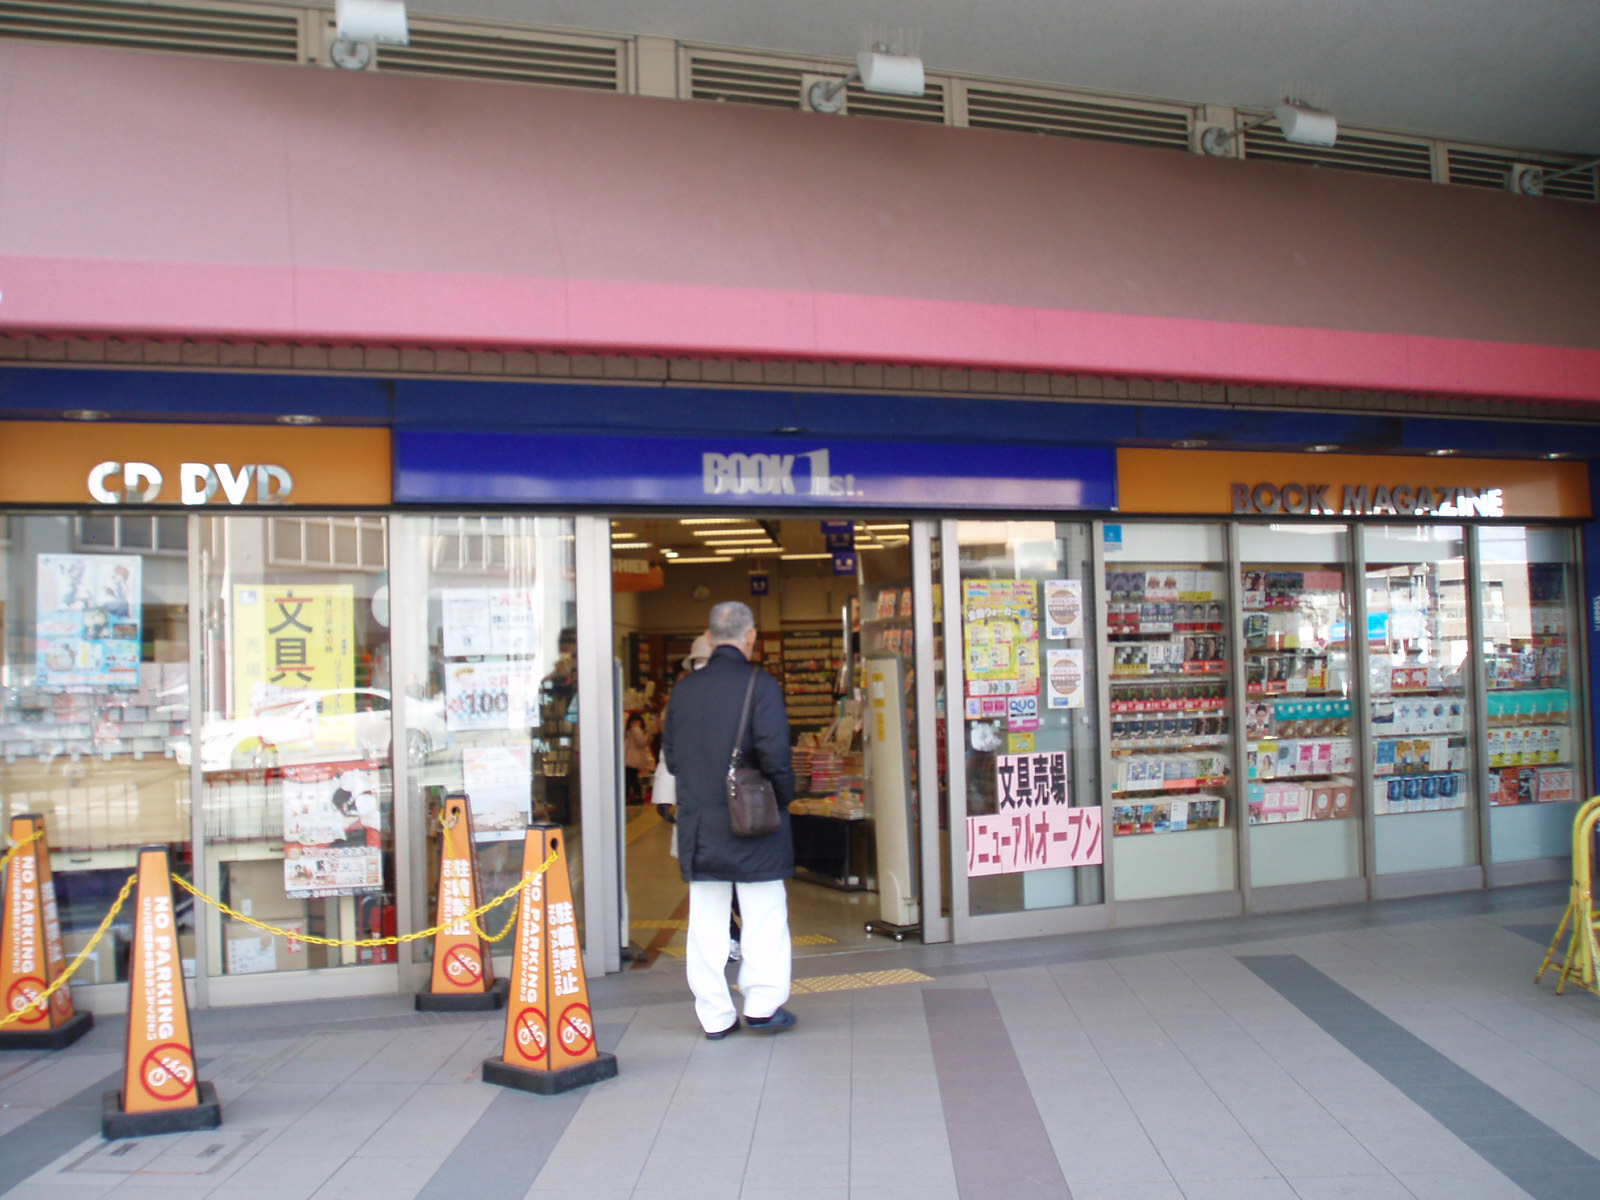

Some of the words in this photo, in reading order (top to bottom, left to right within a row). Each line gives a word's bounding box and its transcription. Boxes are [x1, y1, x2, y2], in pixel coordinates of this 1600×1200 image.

[88, 461, 163, 504] CD
[180, 462, 294, 505] DVD
[702, 452, 796, 495] BOOK
[1230, 482, 1335, 515] BOOK
[1341, 484, 1505, 517] MAGAZINE
[267, 590, 315, 684] 文具
[1010, 699, 1036, 712] QUO
[998, 754, 1066, 810] 文具売場
[966, 808, 1101, 871] リニューアルオープン
[22, 855, 35, 883] NO
[530, 872, 543, 902] NO
[21, 890, 36, 974] PARKING
[153, 895, 170, 930] NO
[547, 903, 557, 926] NO
[527, 907, 541, 1004] PARKING
[550, 929, 563, 997] PARKING
[155, 937, 175, 1040] PARKING
